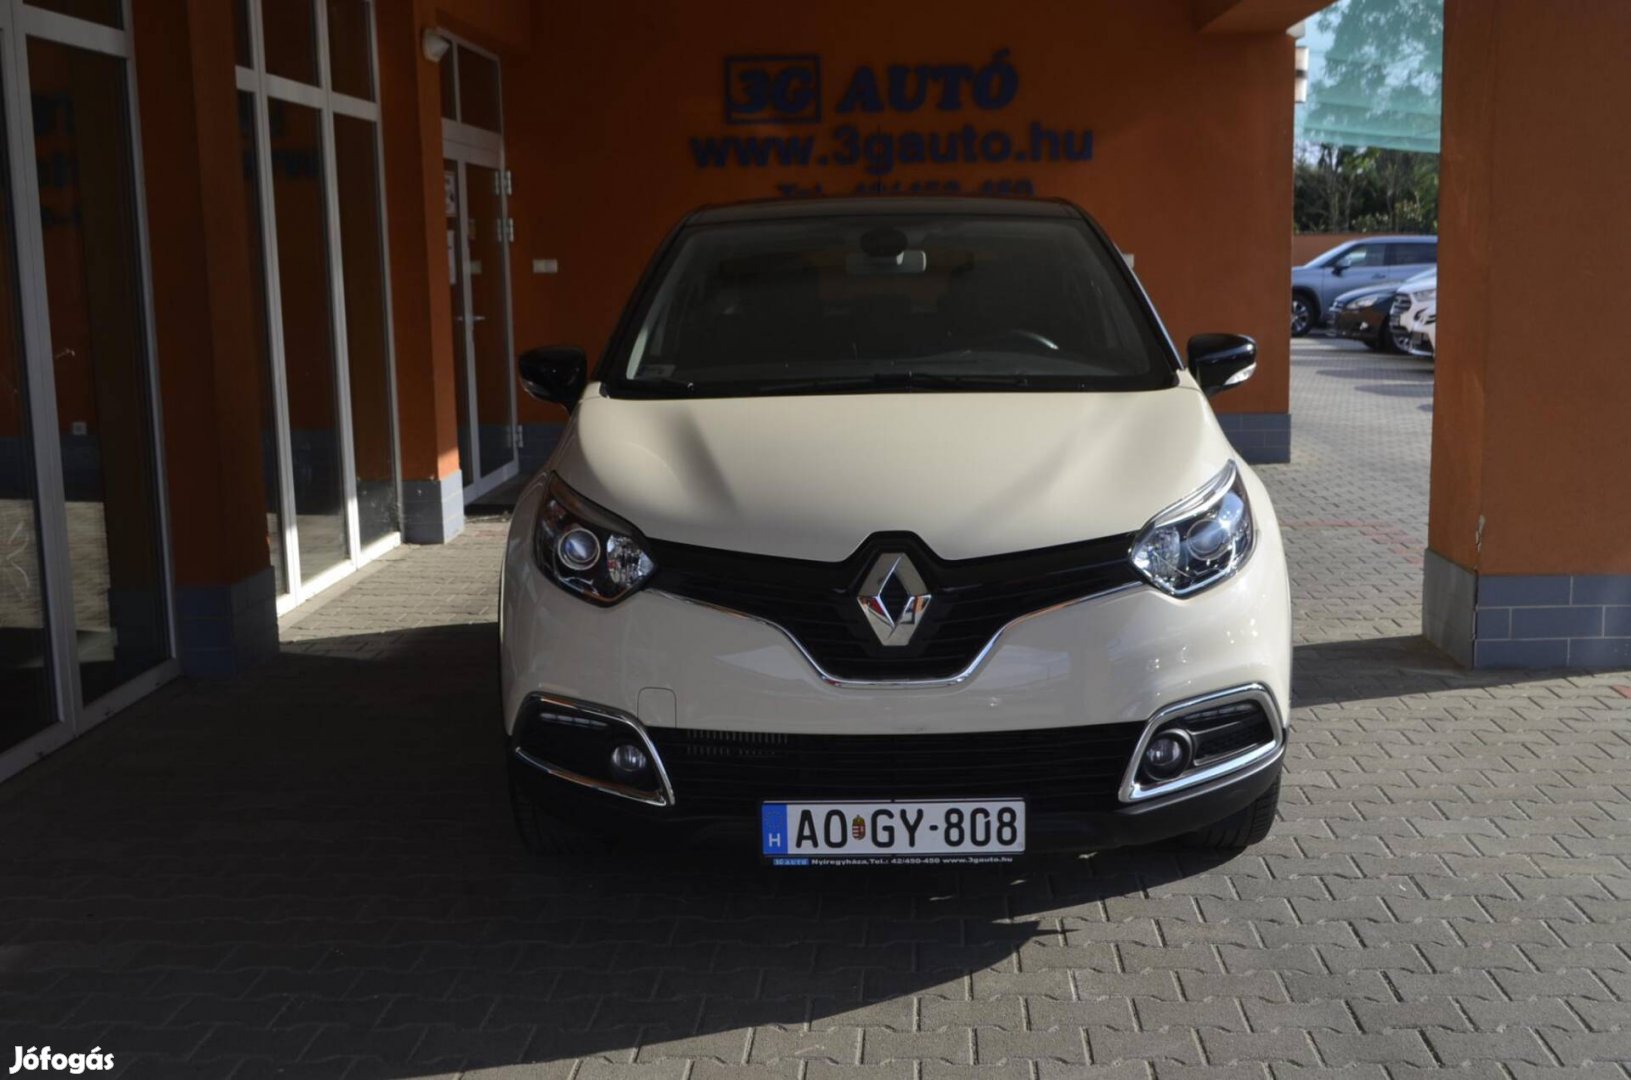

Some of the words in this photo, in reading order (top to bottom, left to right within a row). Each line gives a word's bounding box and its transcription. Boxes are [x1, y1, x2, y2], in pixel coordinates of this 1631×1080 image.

[735, 65, 816, 114] 3G
[835, 48, 1019, 114] AUTÓ
[690, 122, 1094, 176] www.3gauto.hu
[768, 833, 781, 848] H
[795, 809, 848, 849] AO
[870, 807, 1018, 848] GY-808
[942, 856, 1013, 864] www.3gauto.hu
